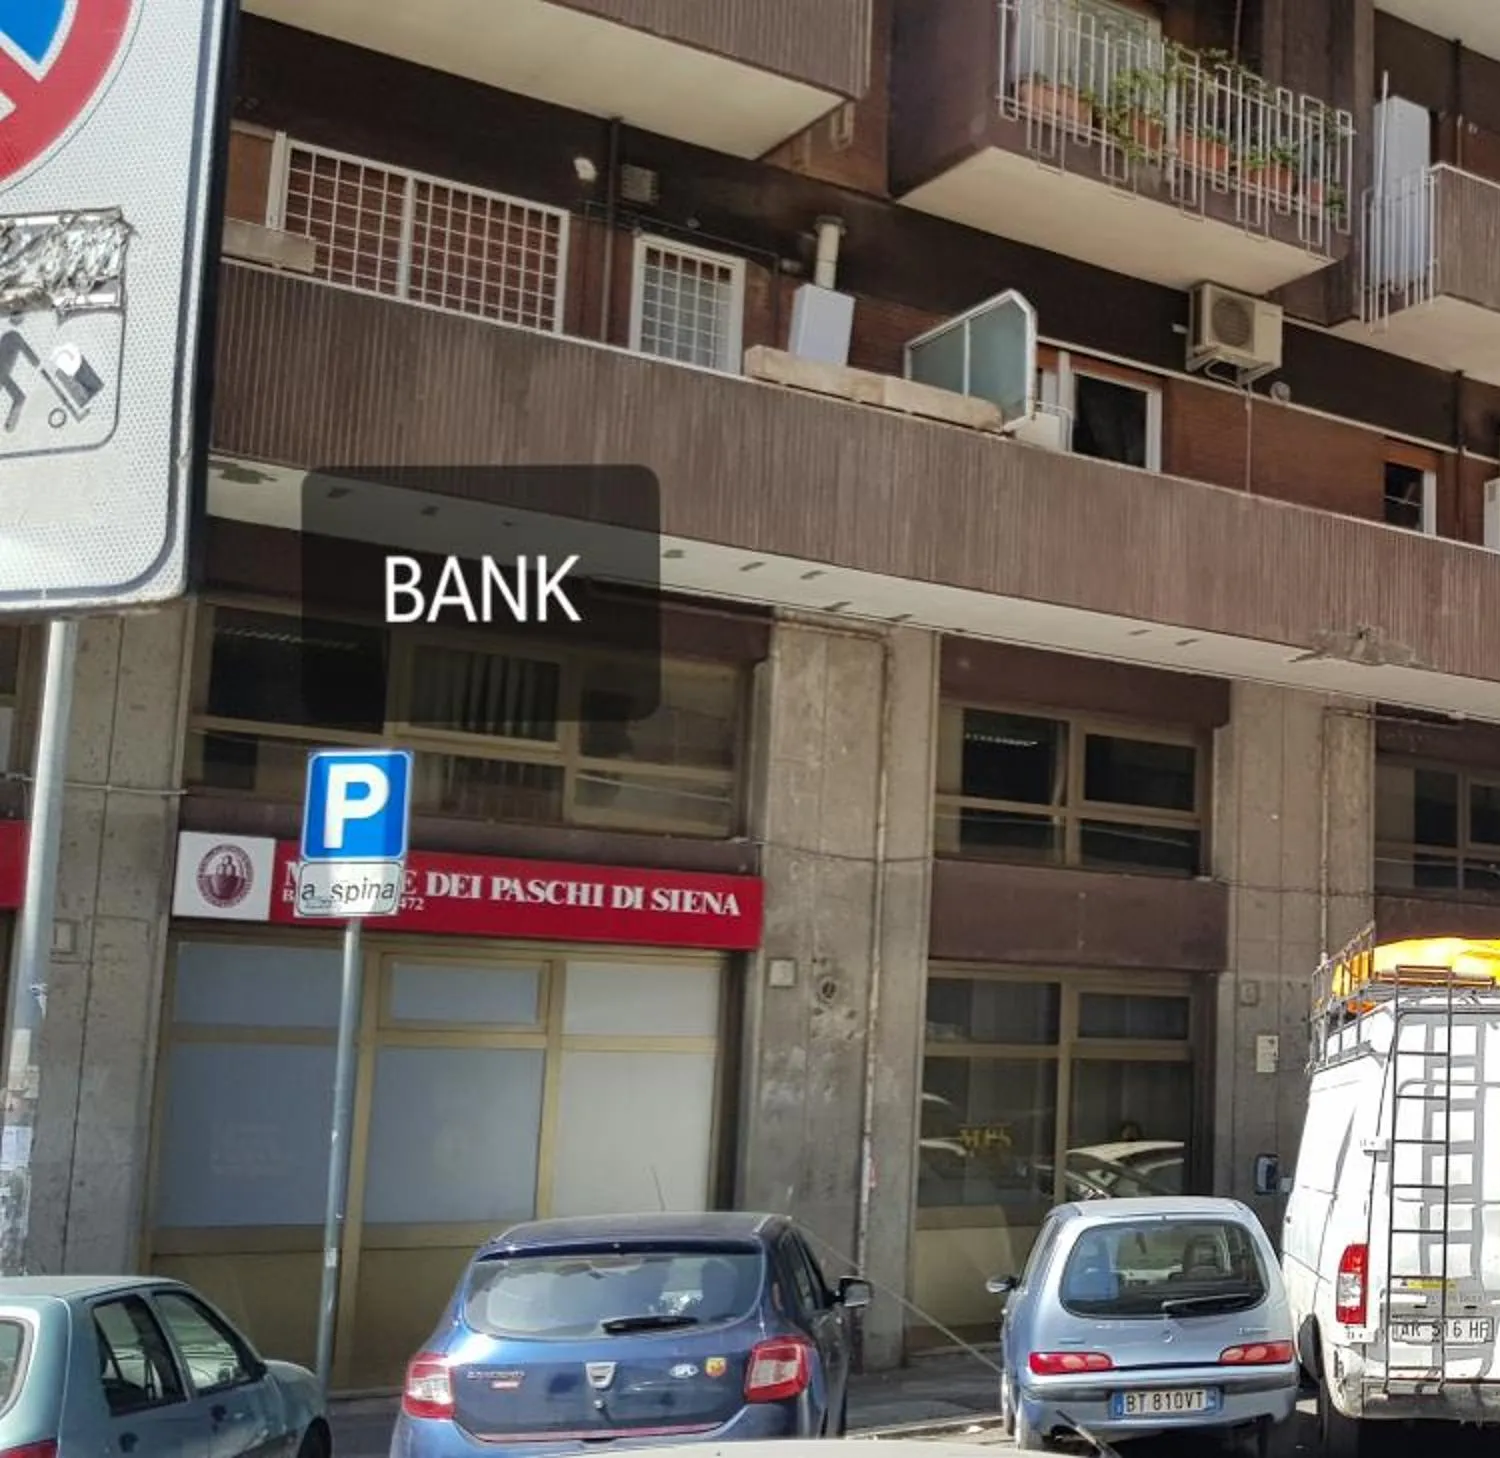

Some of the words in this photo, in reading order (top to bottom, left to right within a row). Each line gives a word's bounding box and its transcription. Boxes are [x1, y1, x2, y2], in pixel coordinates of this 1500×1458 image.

[323, 763, 390, 849] P
[301, 882, 315, 901] a
[331, 876, 395, 905] spina
[426, 870, 482, 899] DEI
[489, 876, 604, 908] PASCHI
[612, 885, 644, 910] DI
[651, 888, 741, 917] SIENA
[1127, 1392, 1147, 1413] BT
